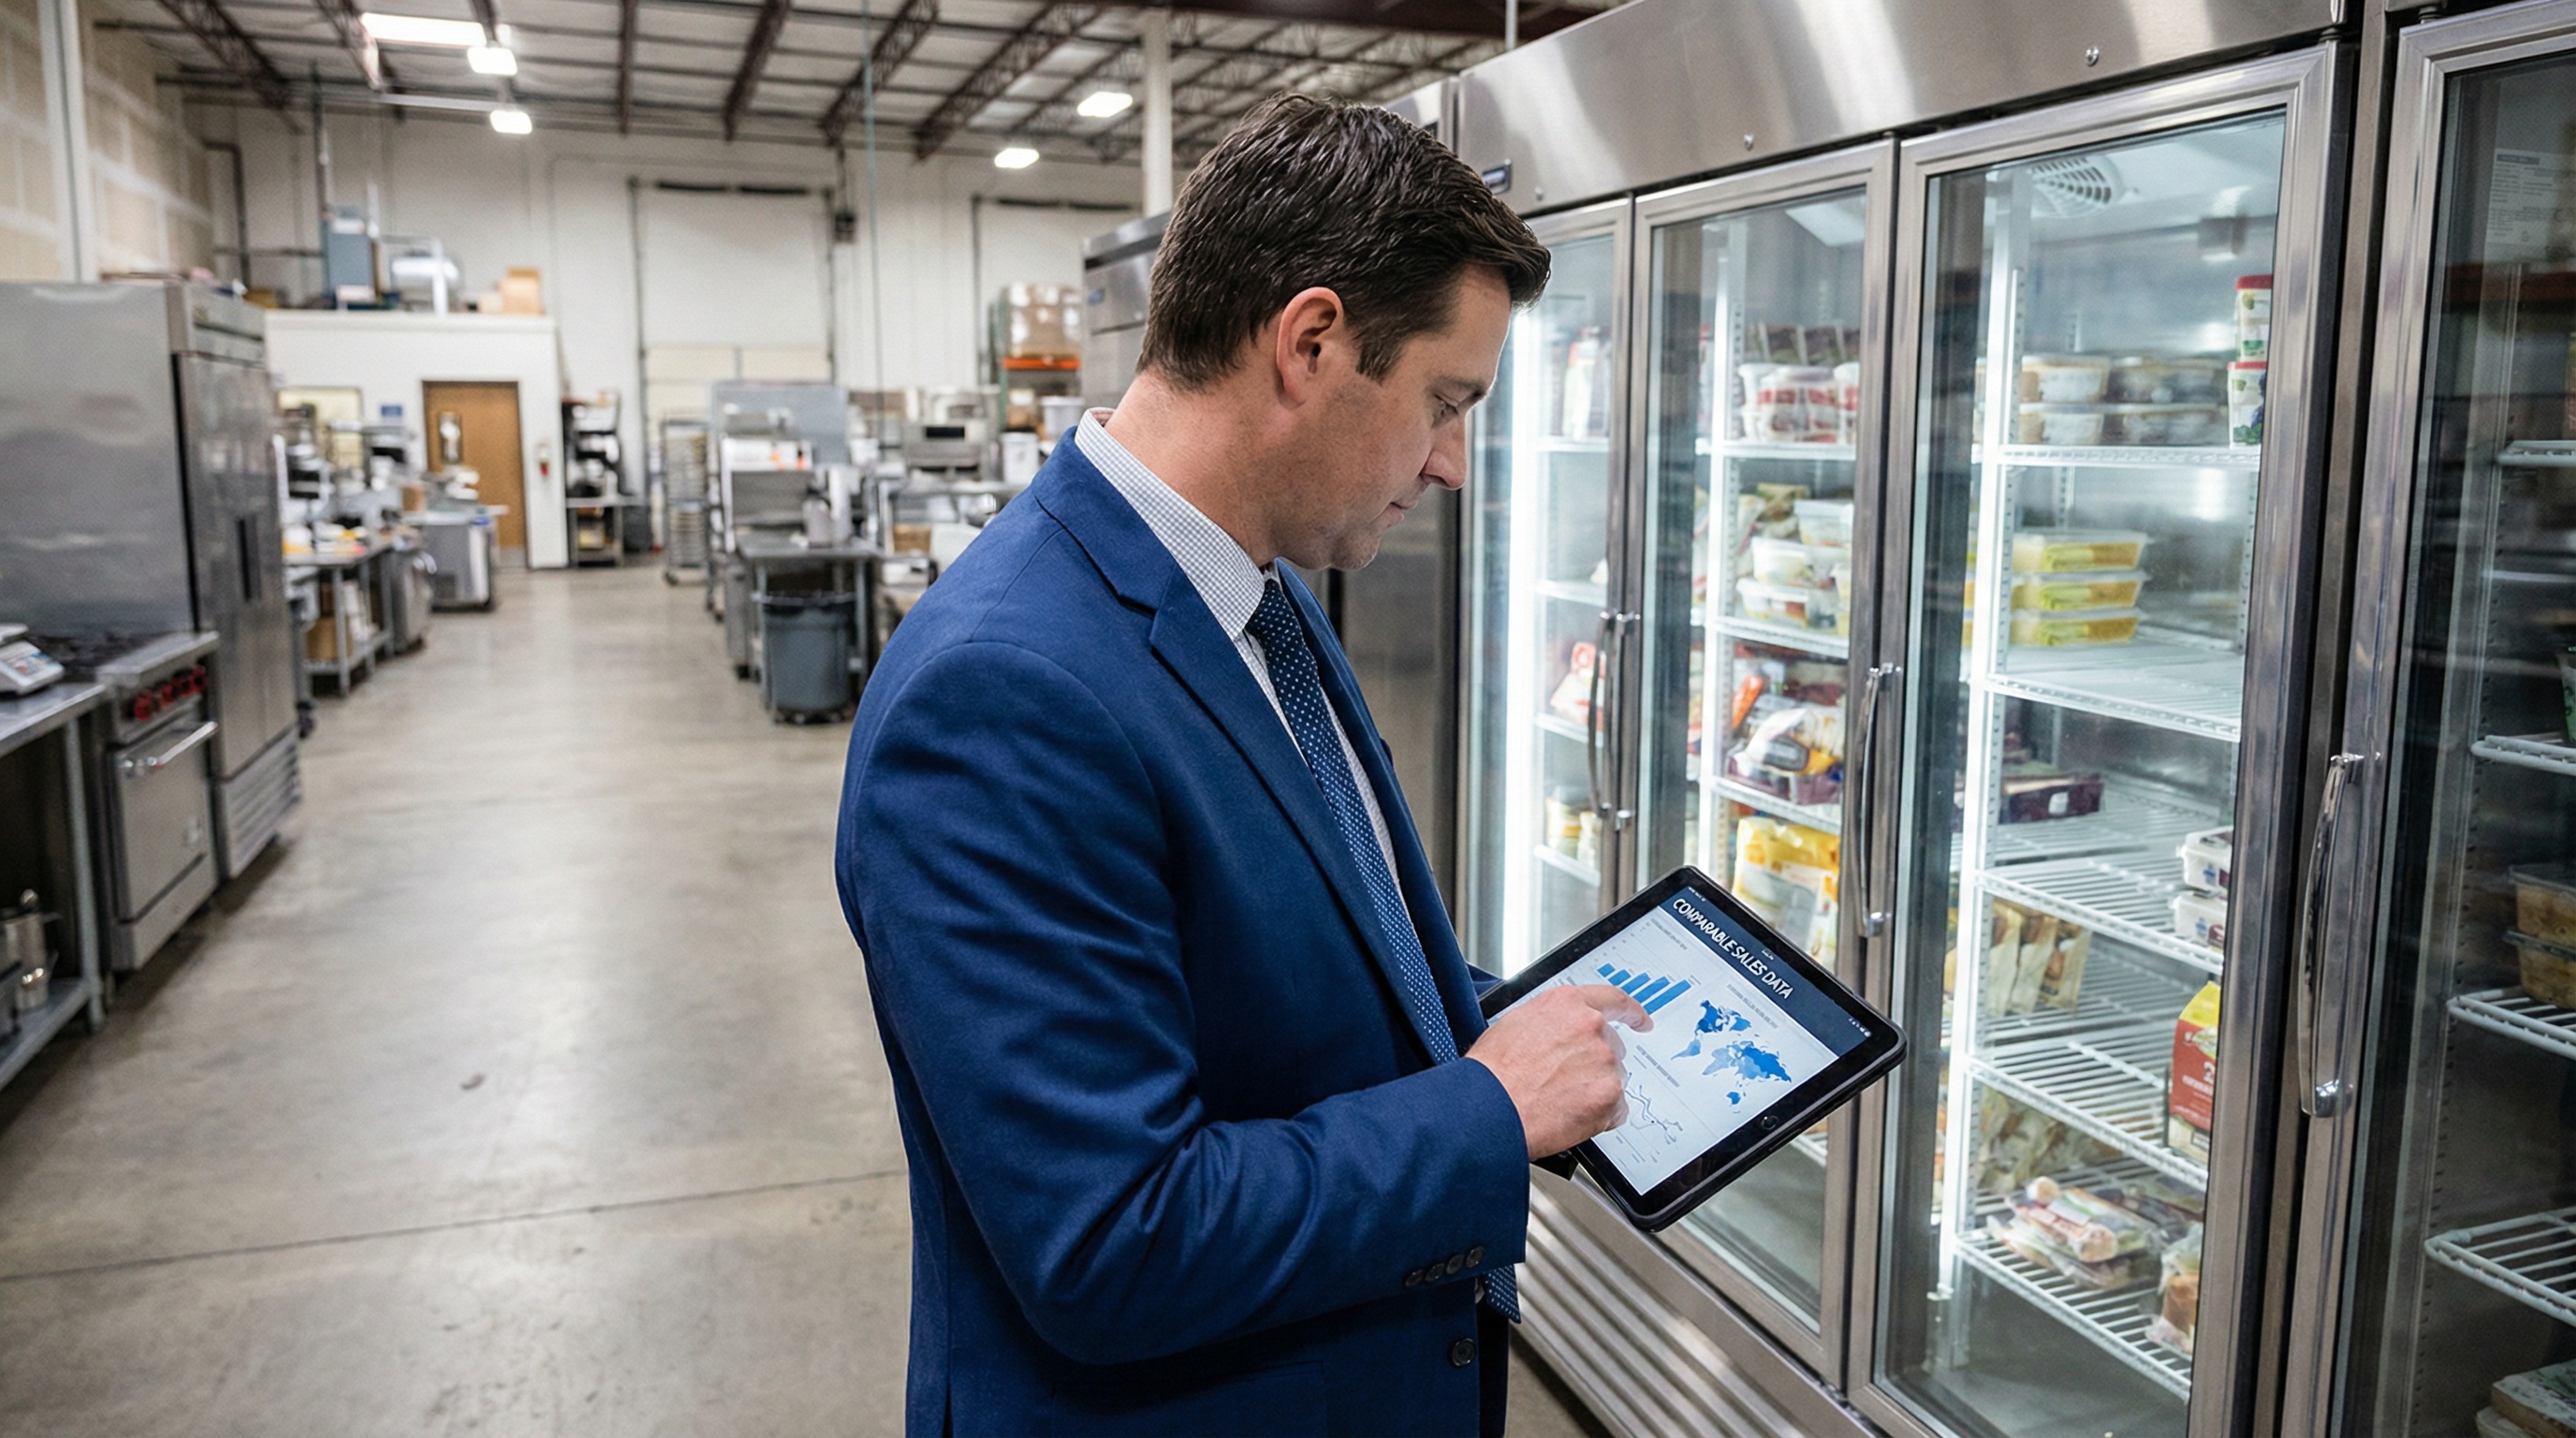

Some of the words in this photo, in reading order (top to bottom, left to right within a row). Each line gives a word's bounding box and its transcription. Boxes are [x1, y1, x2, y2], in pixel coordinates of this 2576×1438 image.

[1673, 898, 1738, 952] COMPARABLE
[1731, 946, 1768, 976] SALES
[1761, 971, 1794, 999] DATA
